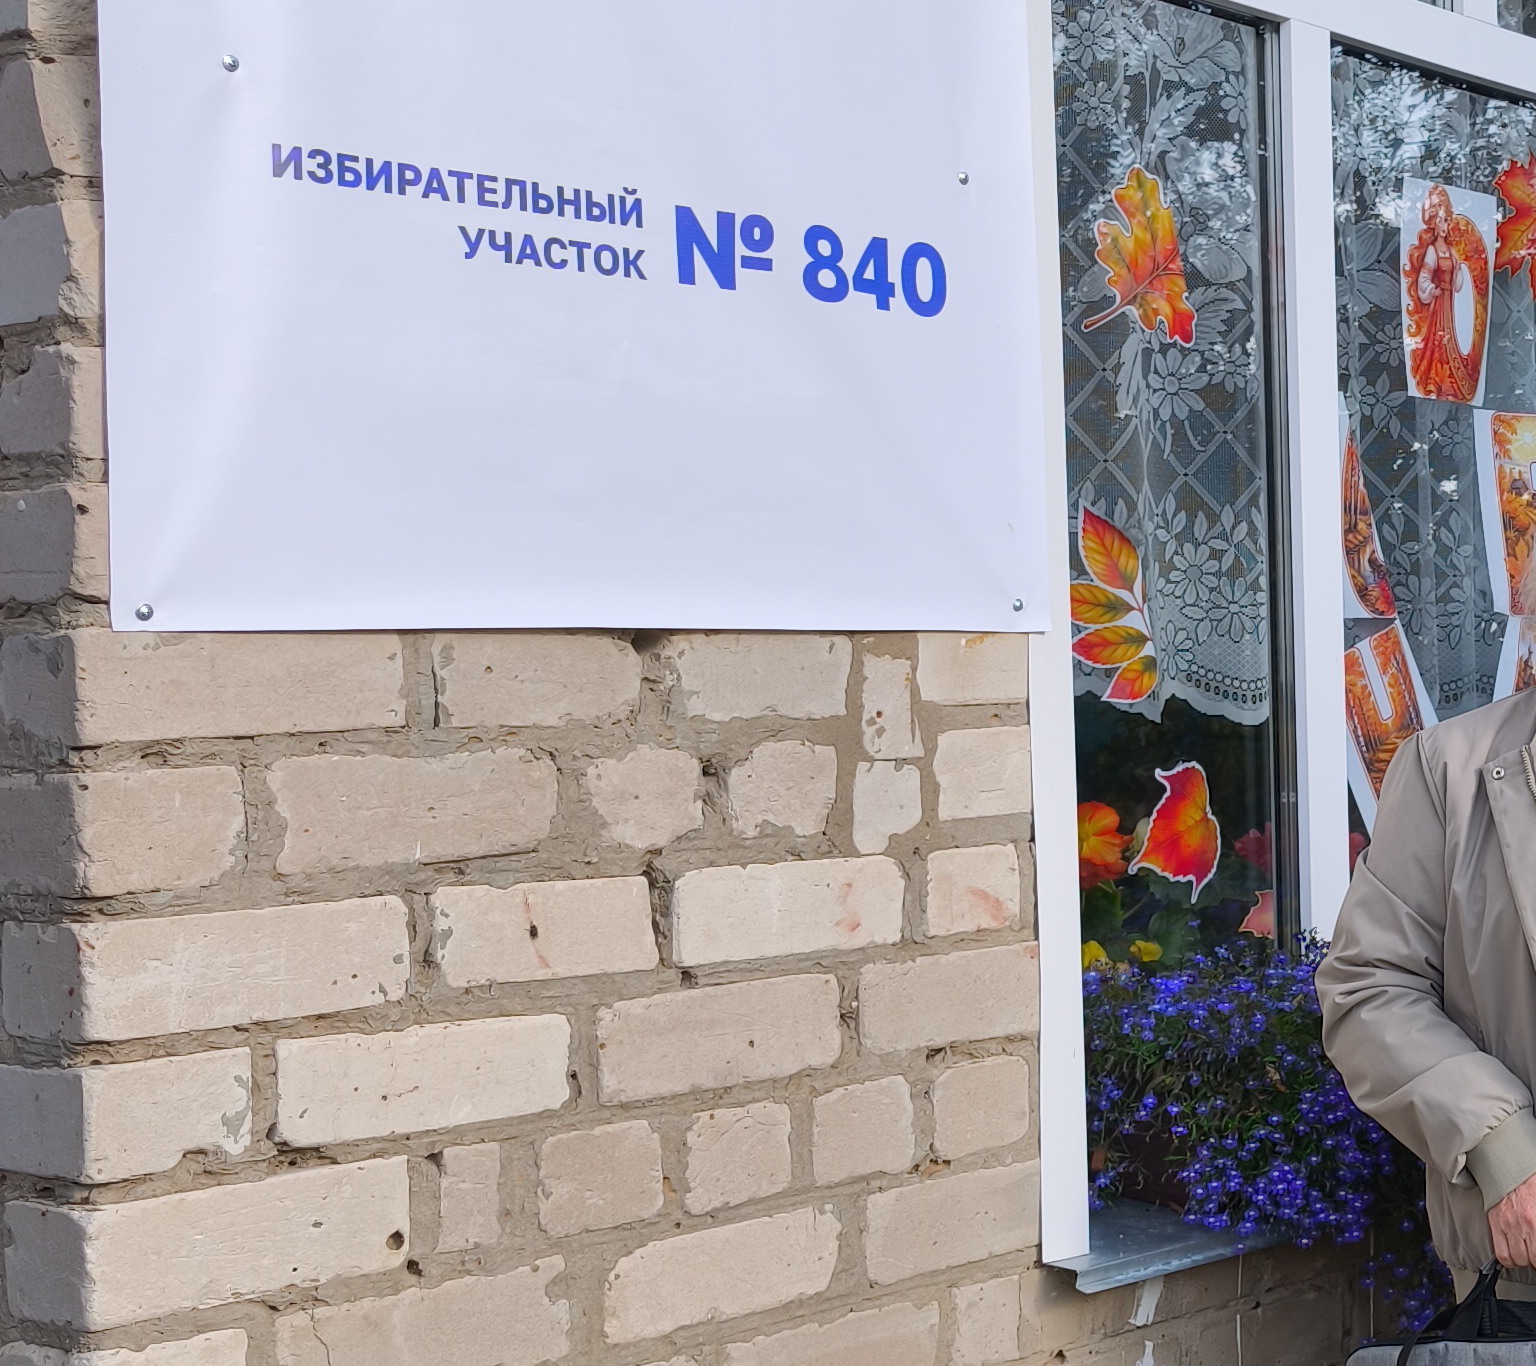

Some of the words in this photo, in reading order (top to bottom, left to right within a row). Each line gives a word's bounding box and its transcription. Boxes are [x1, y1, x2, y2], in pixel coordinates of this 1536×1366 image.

[271, 143, 644, 229] ИЗБИРАТЕЛЬНЫЙ
[457, 226, 647, 281] УЧАСТОК
[674, 205, 774, 291] №
[802, 225, 948, 318] 840
